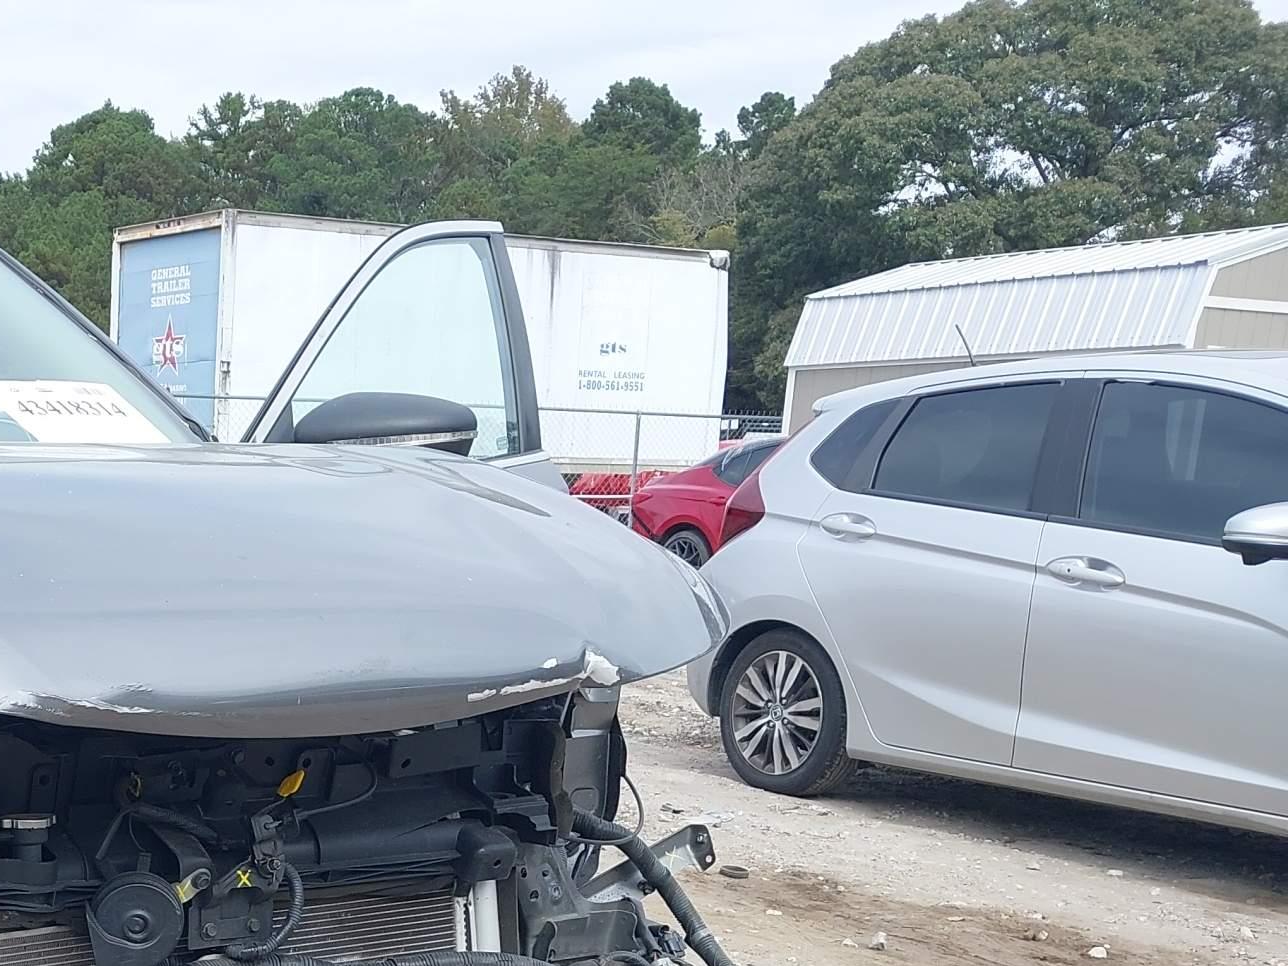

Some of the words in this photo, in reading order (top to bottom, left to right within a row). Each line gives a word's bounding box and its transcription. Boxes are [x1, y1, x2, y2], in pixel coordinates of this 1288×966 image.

[151, 264, 191, 280] GENERAL
[151, 279, 191, 294] TRAILER
[150, 293, 191, 308] SERVICES
[153, 335, 184, 366] gts
[599, 341, 628, 357] gts
[578, 369, 607, 378] RENTAL
[613, 371, 645, 380] LEASING
[17, 400, 128, 418] 43418314
